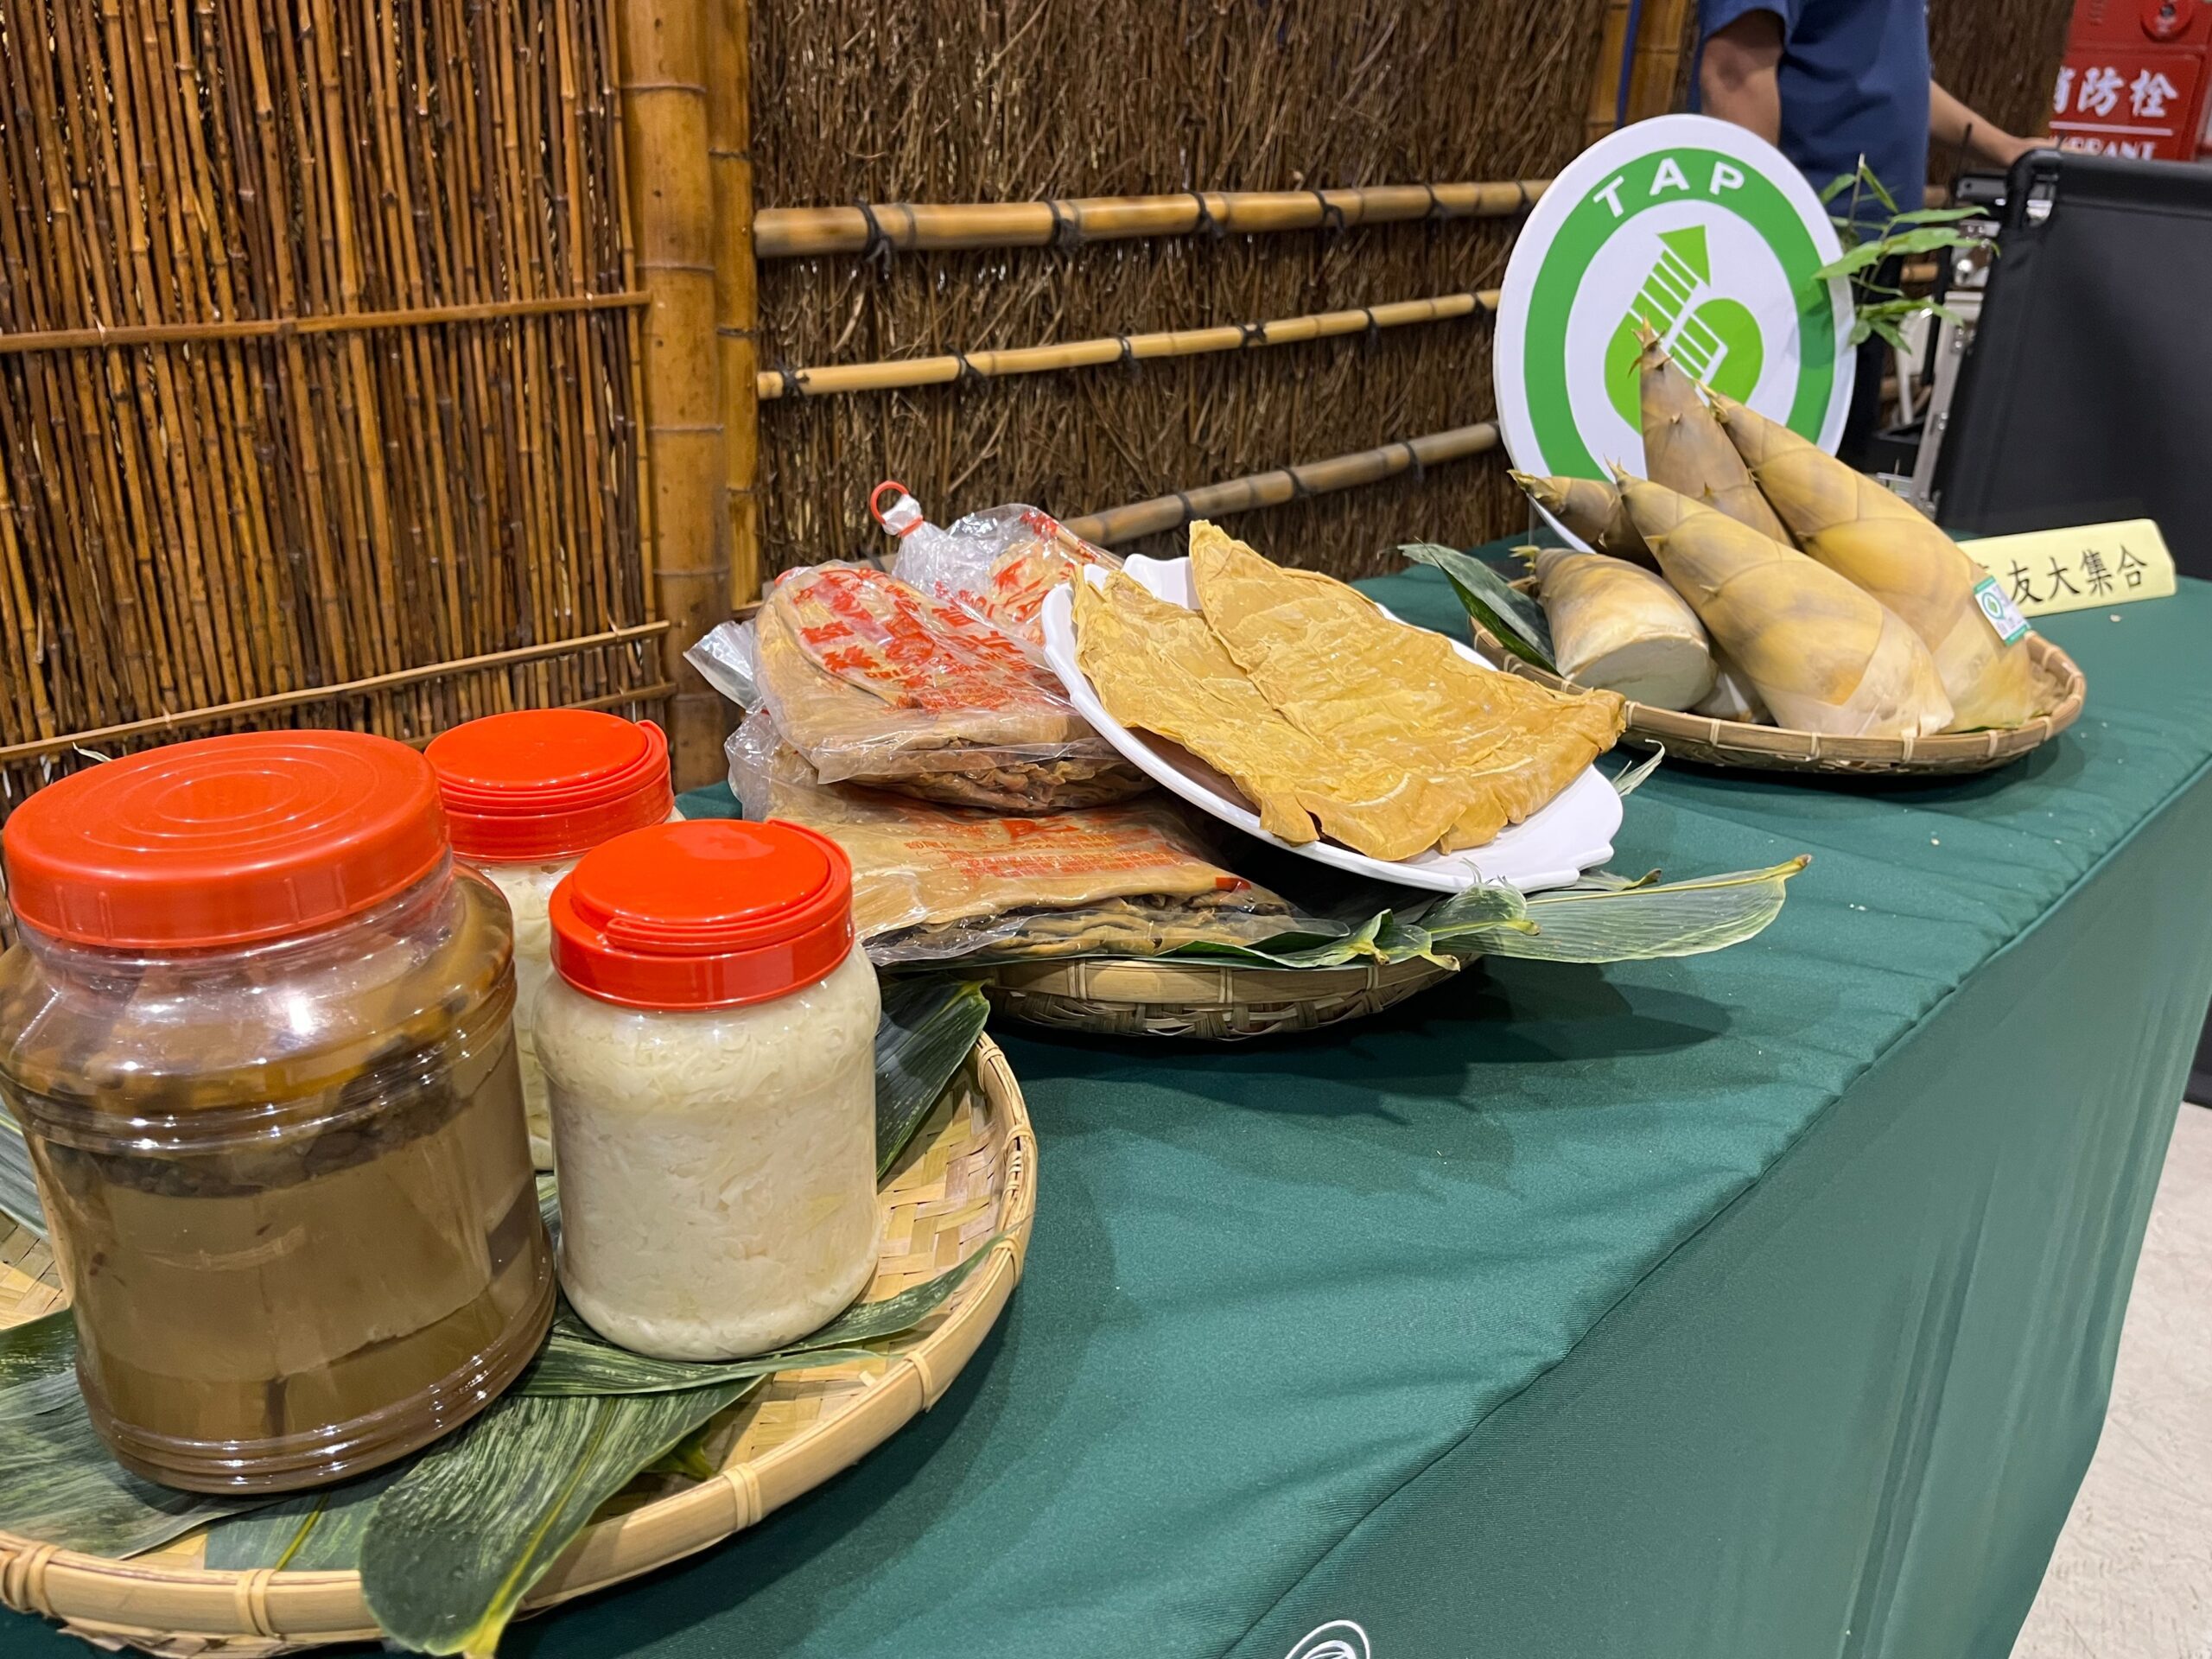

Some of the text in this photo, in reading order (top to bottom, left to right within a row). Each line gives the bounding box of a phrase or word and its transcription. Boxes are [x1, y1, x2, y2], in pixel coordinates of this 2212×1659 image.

[1592, 157, 1745, 219] TAP
[1976, 543, 2148, 607] 友大集合
